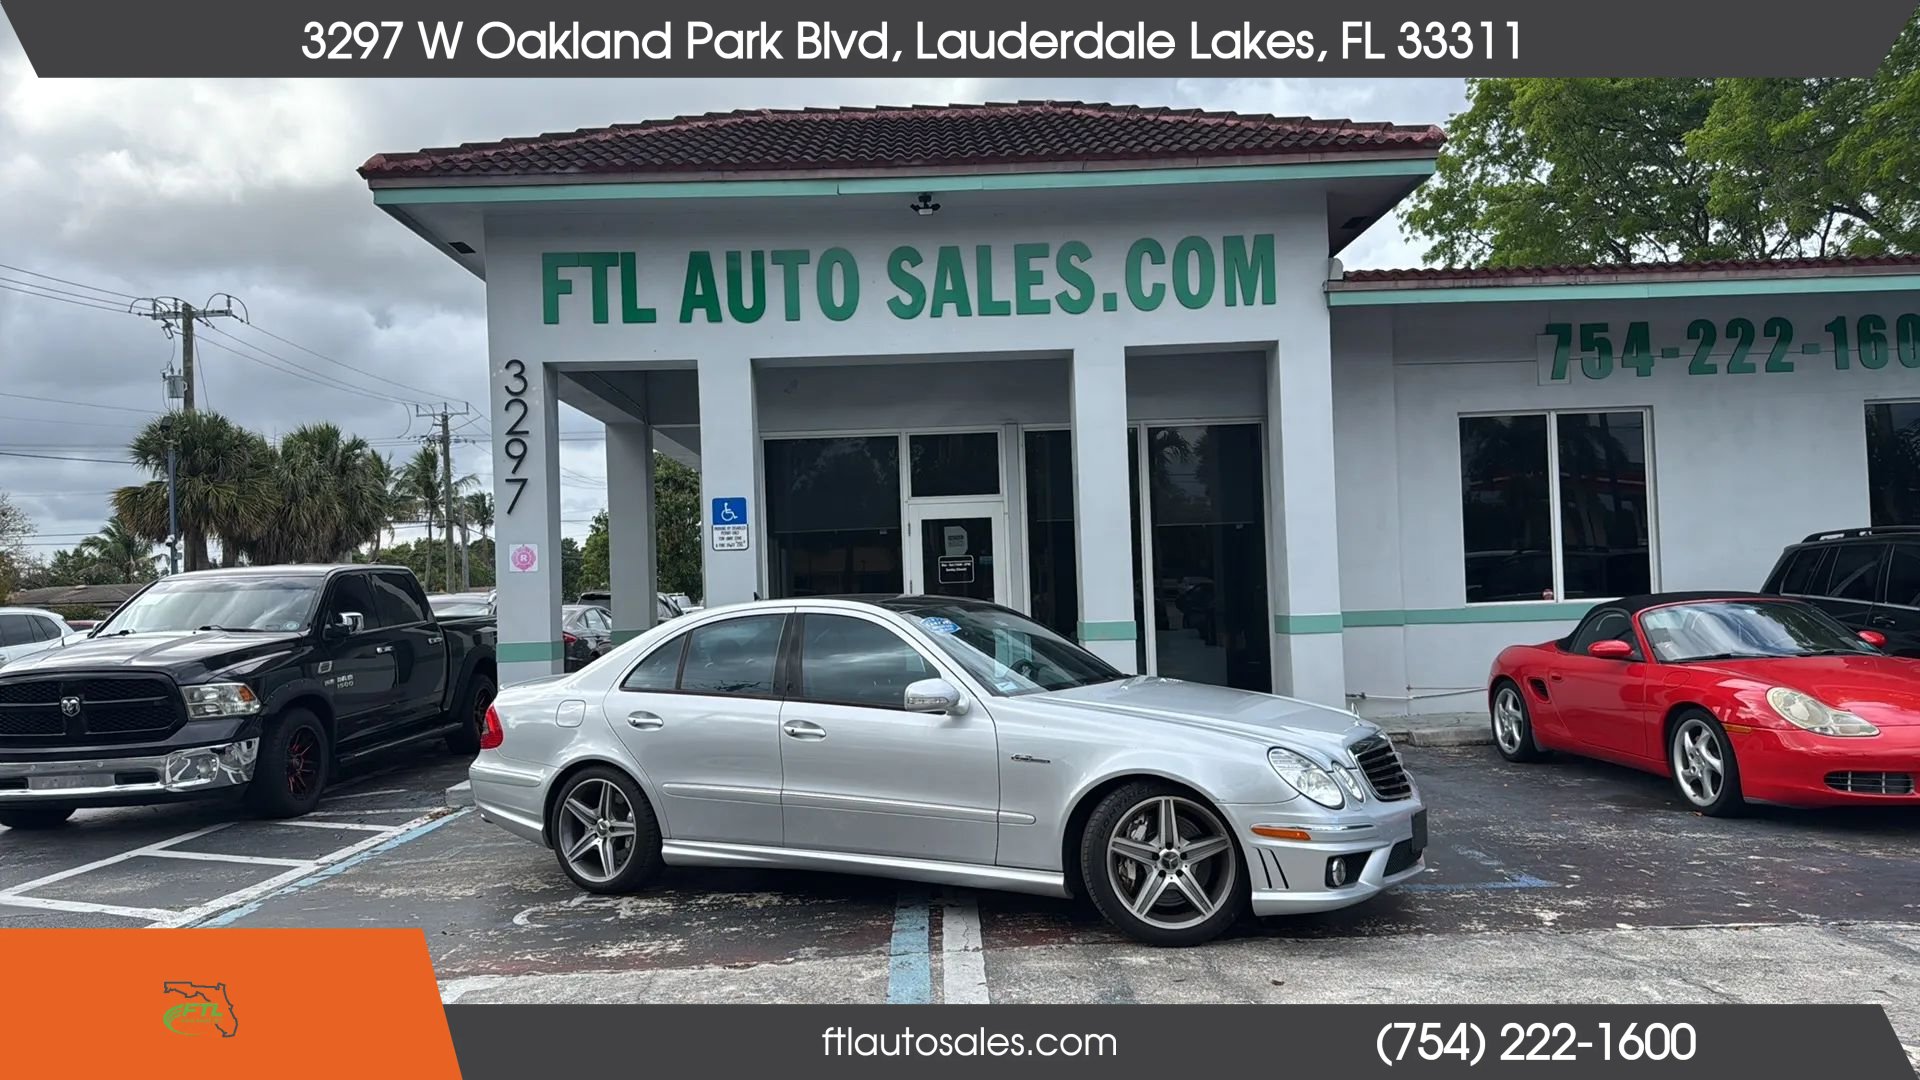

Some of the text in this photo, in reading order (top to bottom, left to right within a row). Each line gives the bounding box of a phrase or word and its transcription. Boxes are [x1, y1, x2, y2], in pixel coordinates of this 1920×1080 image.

[541, 234, 1277, 326] FTL AUTO SALES.COM
[504, 358, 530, 516] 3297
